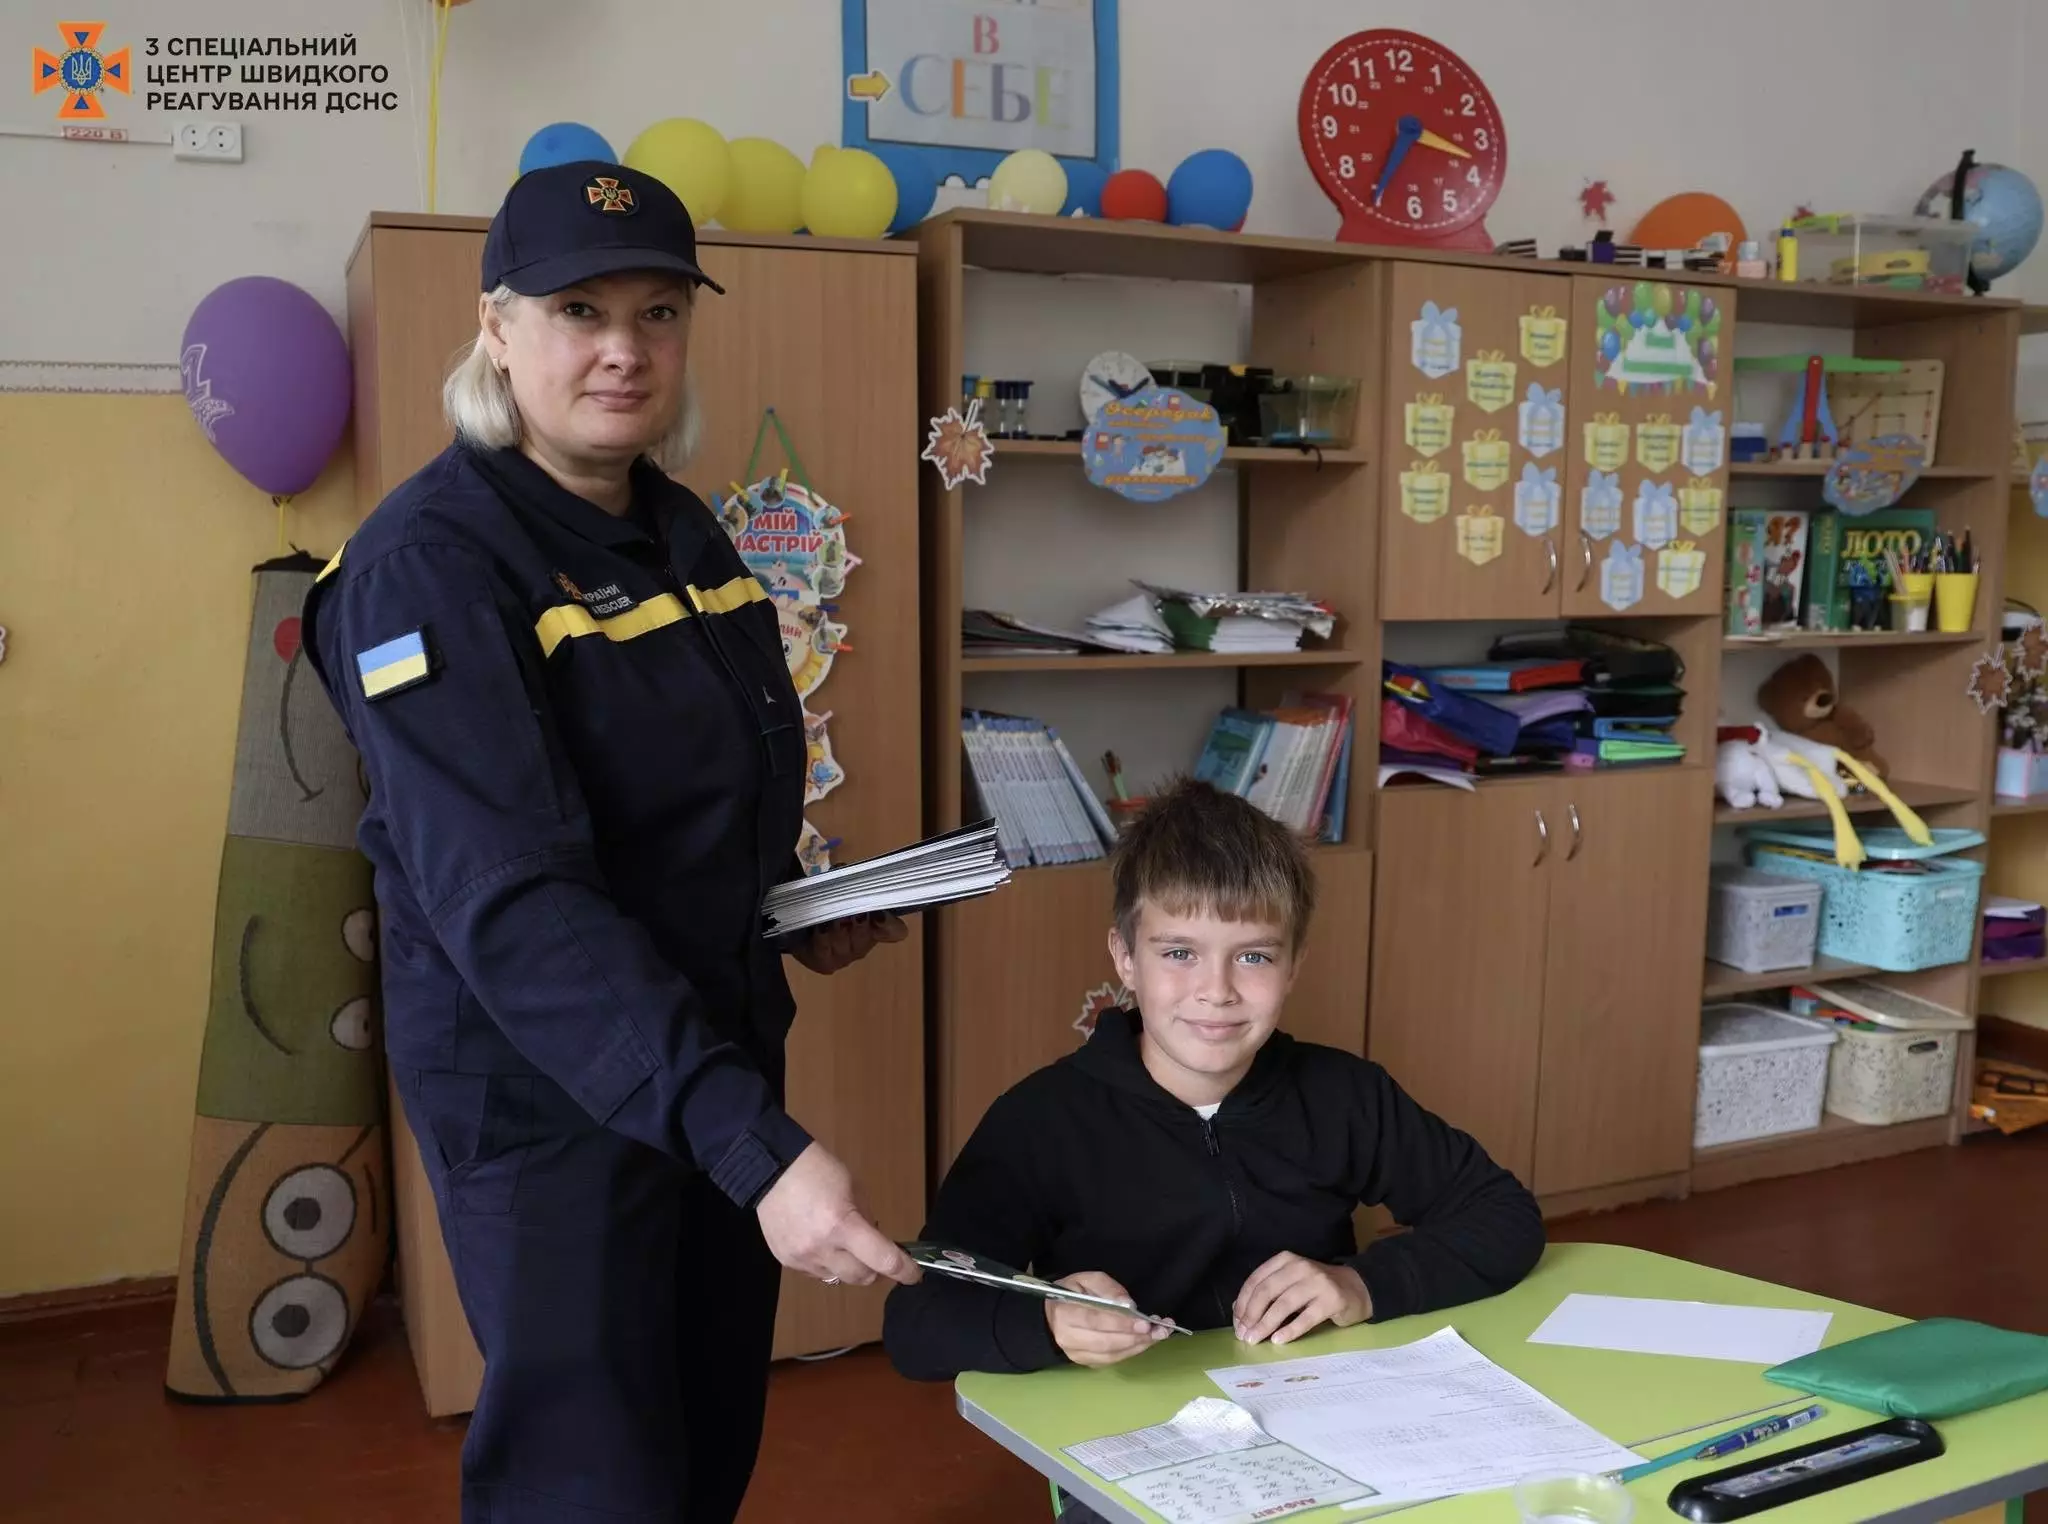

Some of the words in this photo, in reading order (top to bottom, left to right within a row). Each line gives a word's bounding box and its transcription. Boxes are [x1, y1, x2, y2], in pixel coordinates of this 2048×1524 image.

[972, 14, 1000, 55] В
[1349, 57, 1376, 80] 11
[1384, 48, 1414, 73] 12
[1430, 64, 1442, 87] 1
[899, 53, 1071, 130] СЕБЕ
[1328, 82, 1358, 107] 10
[1460, 93, 1477, 117] 2
[69, 128, 103, 138] 220
[1321, 114, 1338, 139] 9
[1473, 127, 1489, 151] 3
[1338, 155, 1356, 179] 8
[1465, 165, 1481, 188] 4
[1406, 195, 1423, 220] 6
[1442, 189, 1457, 212] 5
[753, 508, 797, 531] МІЙ
[1841, 528, 1922, 559] ЛОТО
